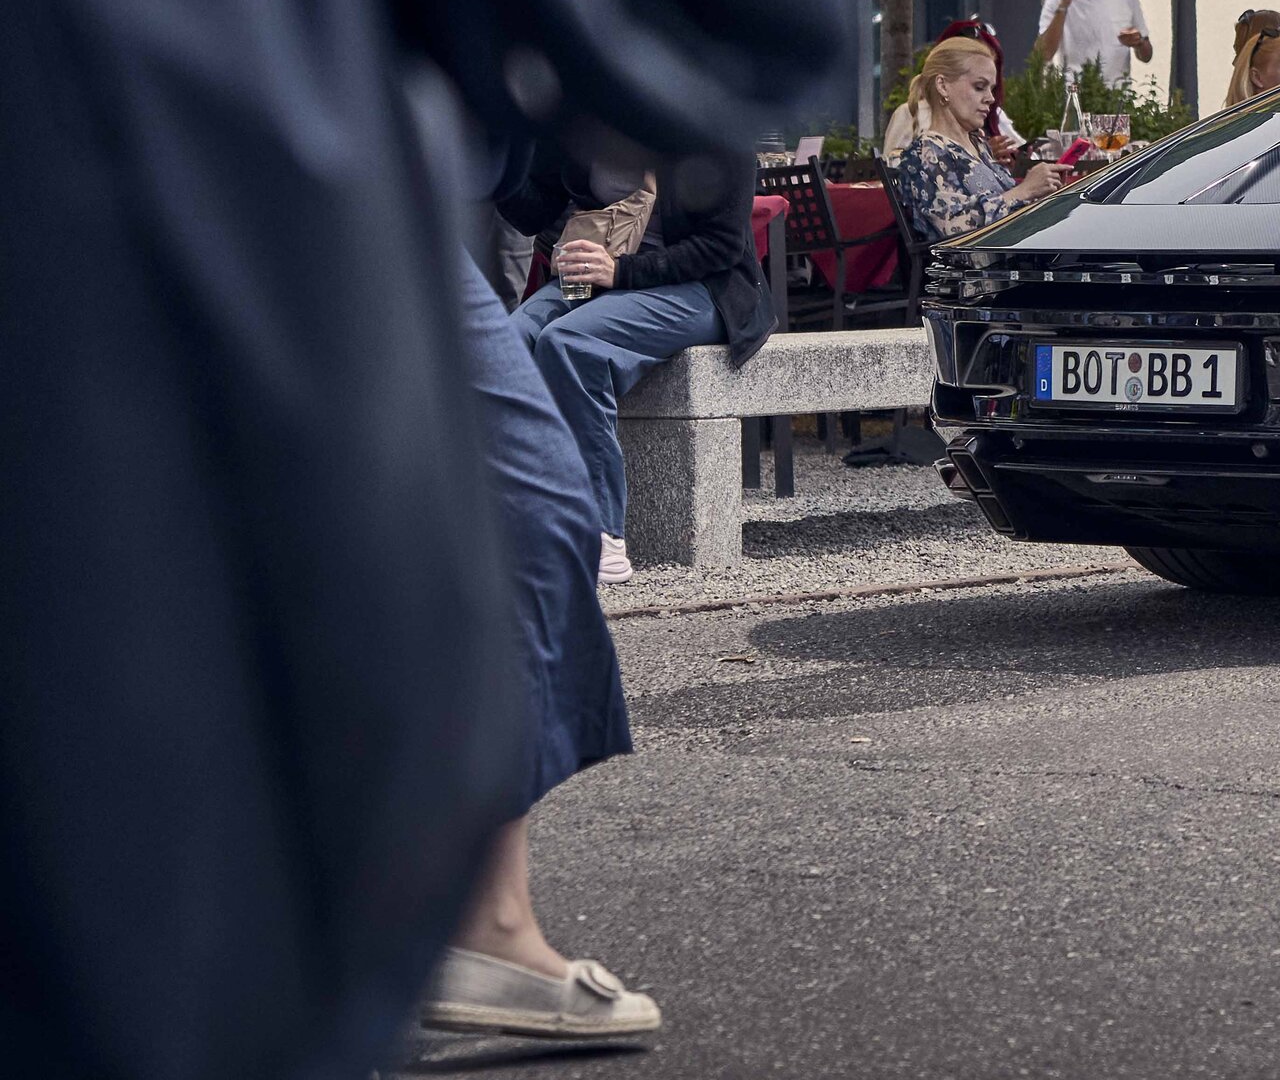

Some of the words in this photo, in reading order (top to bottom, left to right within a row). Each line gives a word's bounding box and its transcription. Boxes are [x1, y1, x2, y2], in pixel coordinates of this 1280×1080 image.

[1010, 270, 1219, 285] BRABUS
[1062, 350, 1125, 395] BOT
[1147, 353, 1192, 397] BB
[1201, 354, 1222, 398] 1
[1040, 379, 1048, 392] D
